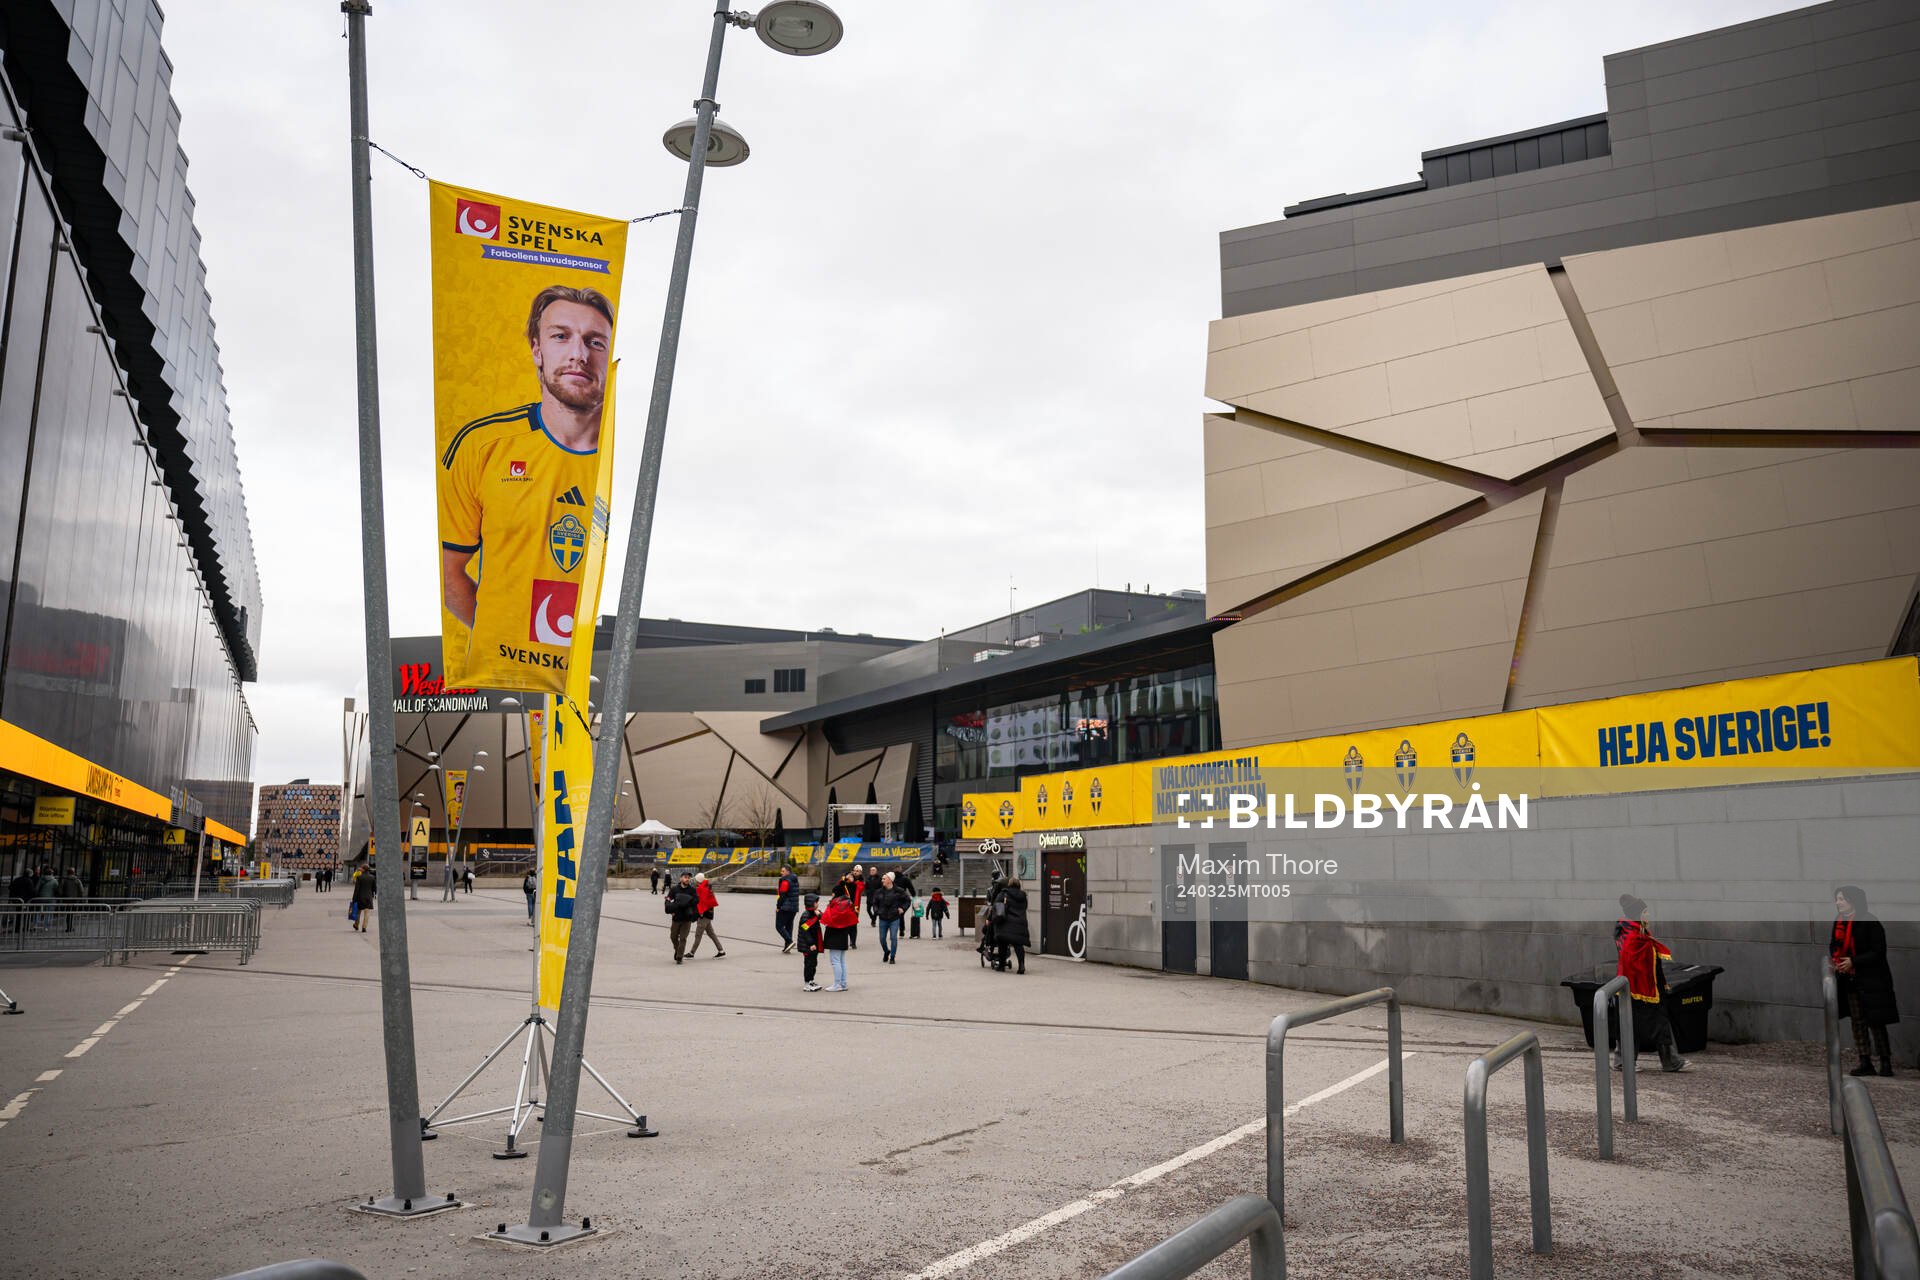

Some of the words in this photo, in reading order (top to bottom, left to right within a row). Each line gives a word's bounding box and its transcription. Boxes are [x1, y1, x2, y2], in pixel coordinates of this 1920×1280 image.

[508, 216, 603, 246] SVENSKA
[508, 231, 558, 252] SPEL
[491, 248, 539, 262] Fotbollens
[539, 255, 603, 270] huvudsponsor
[500, 644, 568, 670] SVENSK
[414, 698, 427, 713] OF
[427, 696, 489, 713] SCANDINAVIA
[1598, 721, 1669, 767] HEJA
[1674, 701, 1831, 760] SVERIGE!
[1160, 759, 1233, 790] VÄLKOMMEN
[1235, 756, 1262, 782] TILL
[166, 832, 176, 842] A
[415, 821, 426, 836] A
[1039, 833, 1069, 848] Cykelrum
[870, 847, 891, 857] GULA
